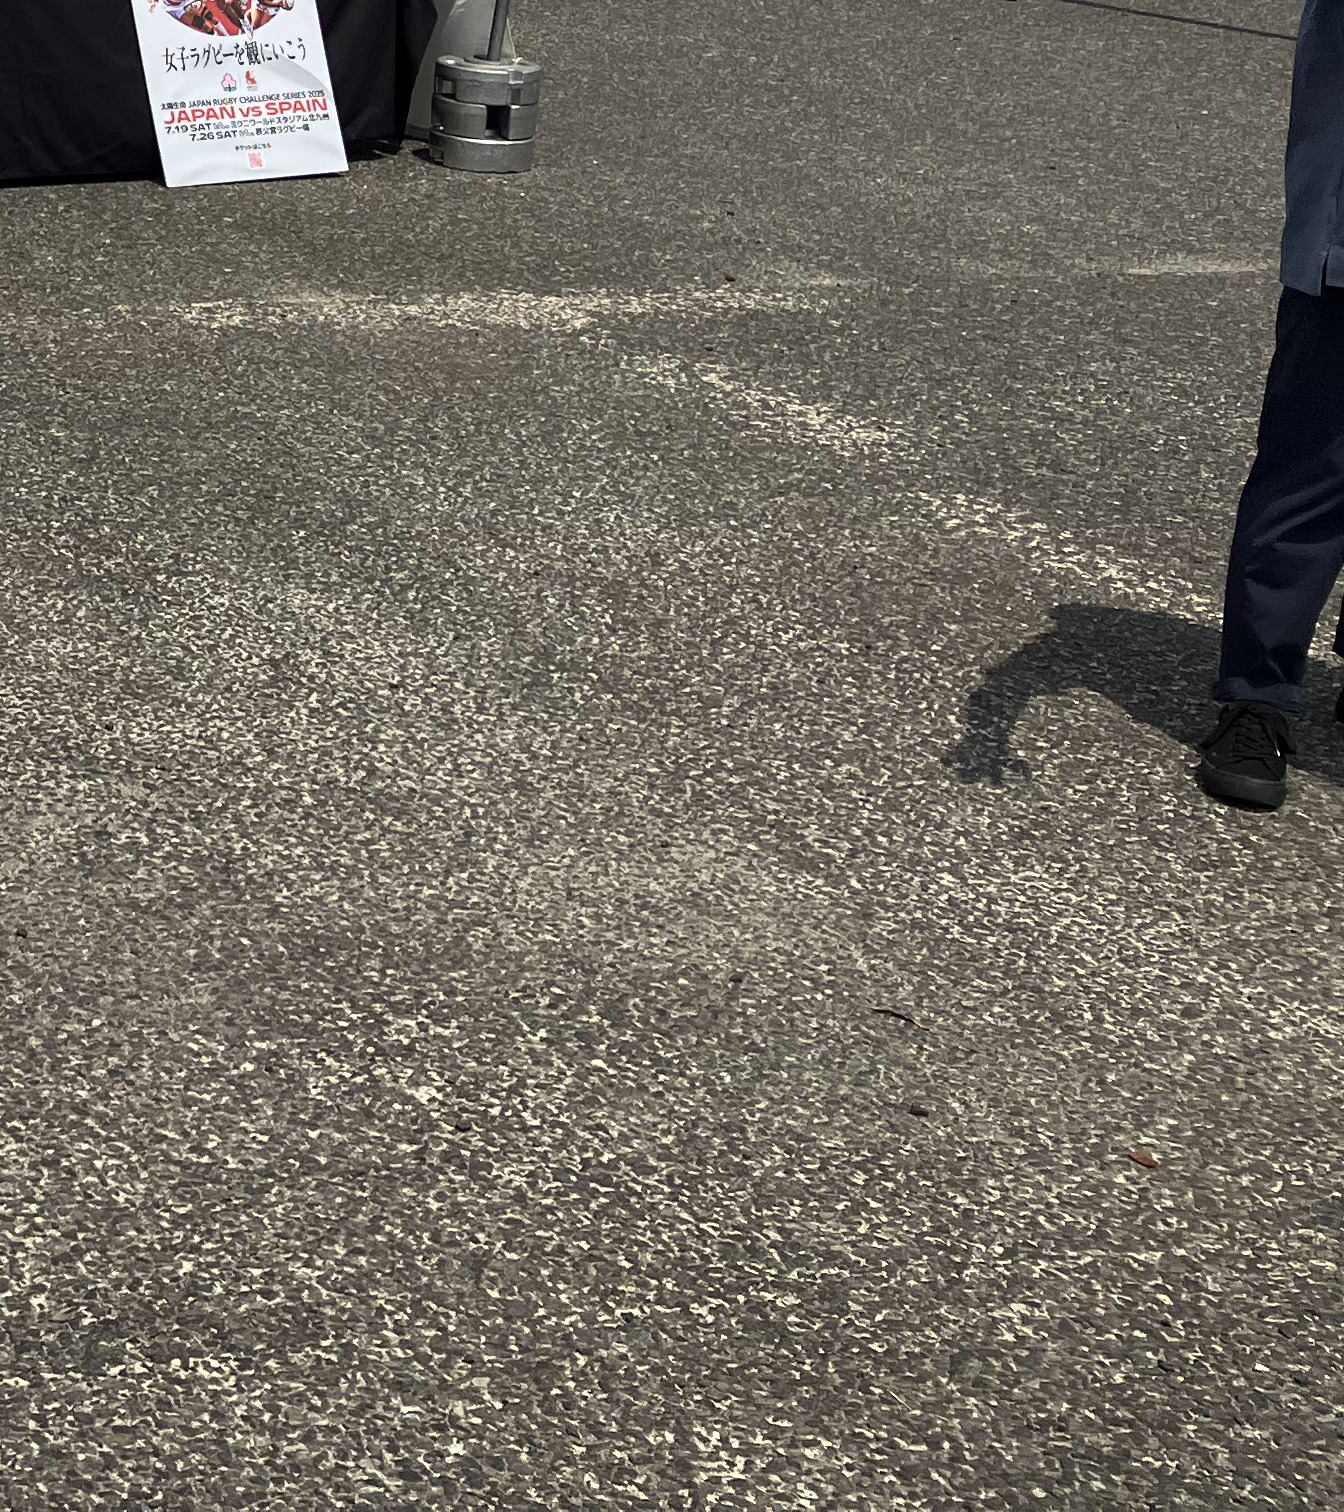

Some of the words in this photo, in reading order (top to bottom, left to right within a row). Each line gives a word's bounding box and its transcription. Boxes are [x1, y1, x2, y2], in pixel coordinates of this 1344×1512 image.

[164, 107, 235, 124] JAPAN
[265, 99, 327, 116] SPAIN
[164, 125, 188, 134] 7.19
[190, 123, 212, 132] SAT
[189, 133, 215, 141] 7.26
[216, 130, 237, 139] SAT
